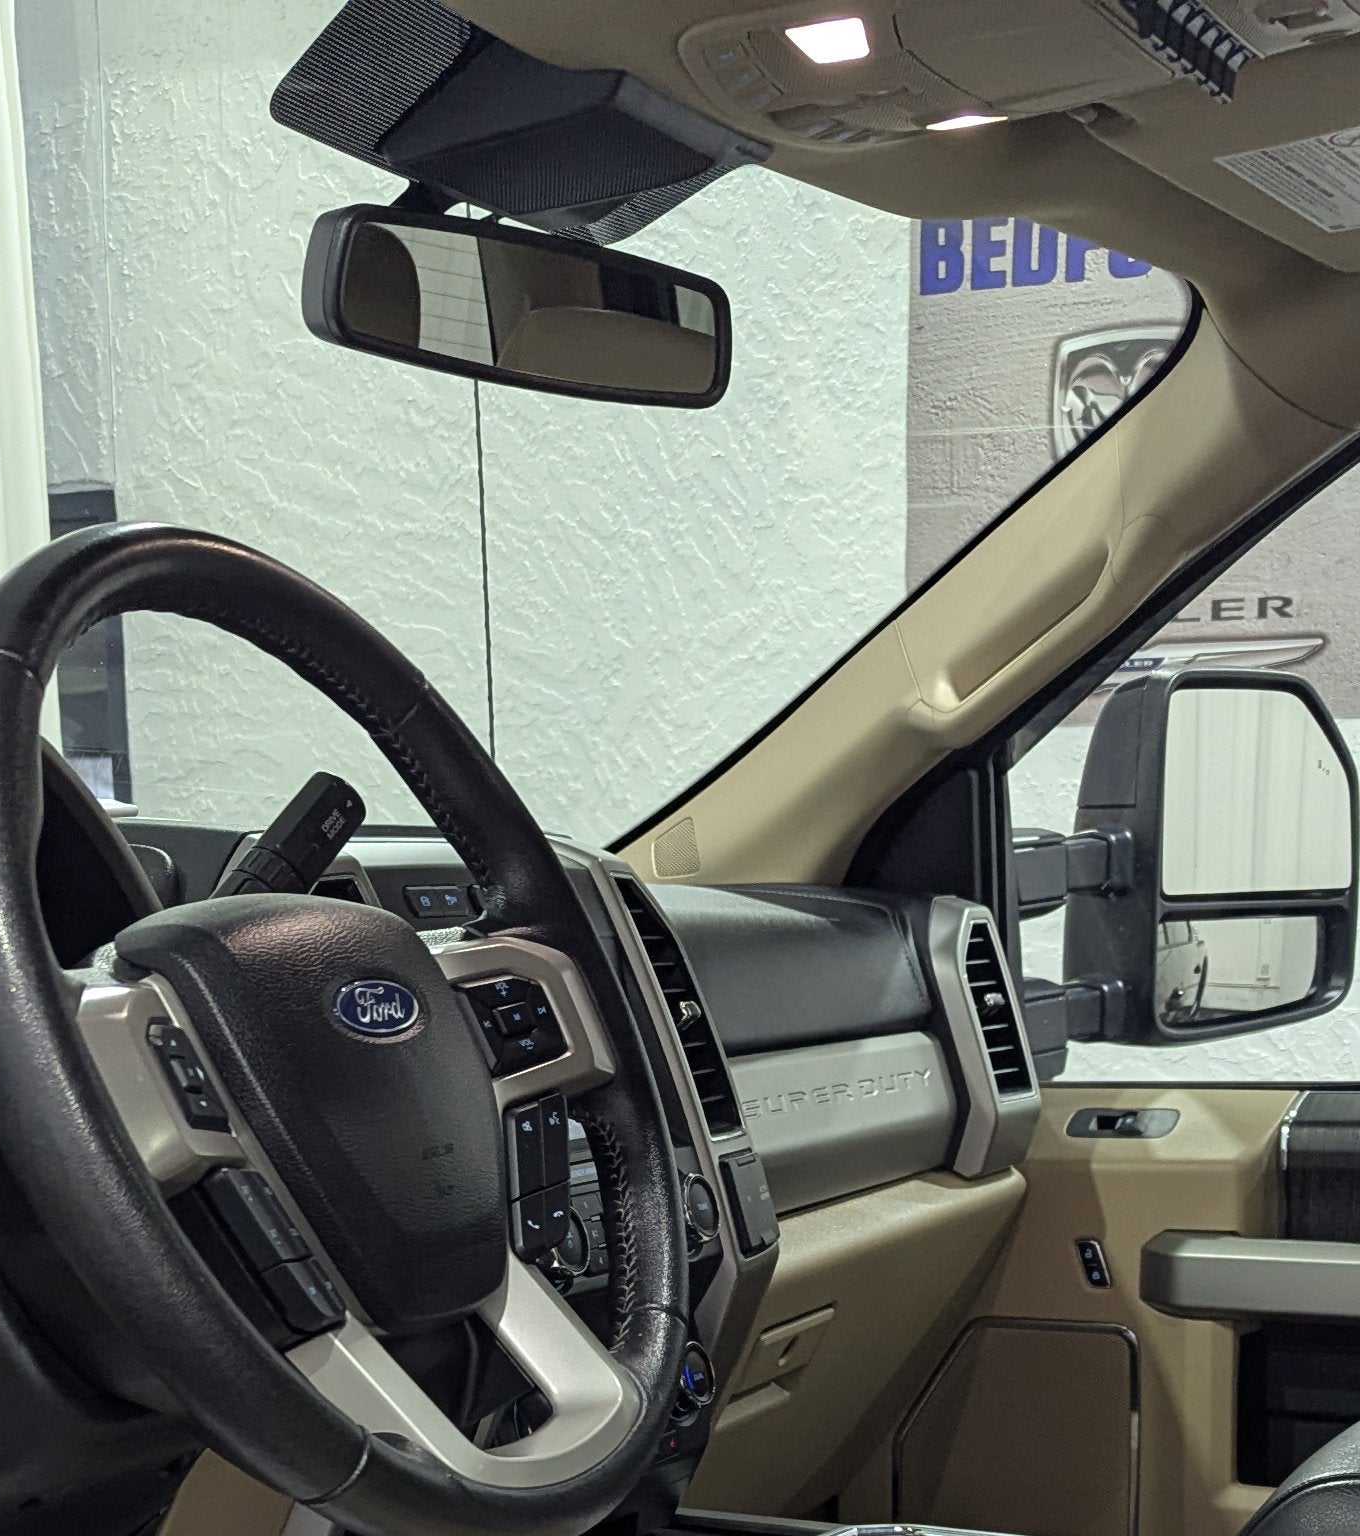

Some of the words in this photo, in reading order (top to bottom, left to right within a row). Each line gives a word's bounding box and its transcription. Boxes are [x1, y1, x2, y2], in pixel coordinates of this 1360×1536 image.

[354, 986, 406, 1023] Ford
[741, 1082, 854, 1120] SUPER
[857, 1066, 931, 1098] DUTY
